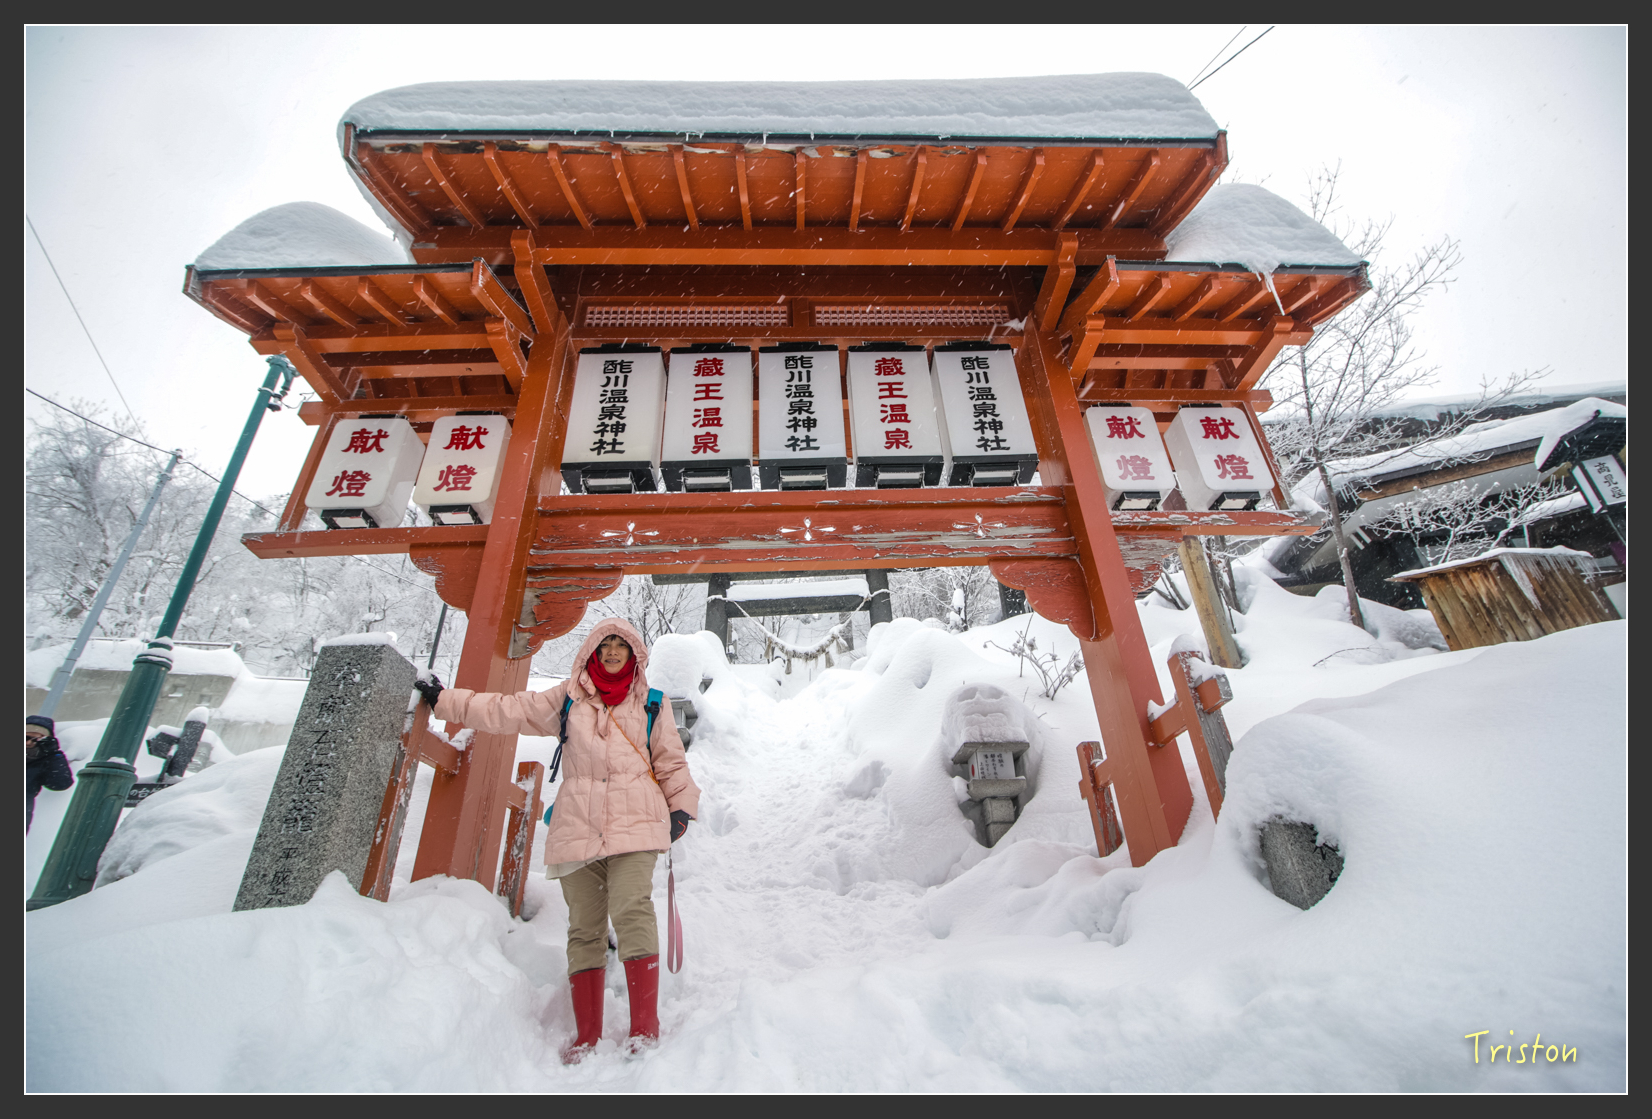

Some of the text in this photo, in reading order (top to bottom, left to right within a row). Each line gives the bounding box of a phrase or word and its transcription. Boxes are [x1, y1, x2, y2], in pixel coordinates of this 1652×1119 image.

[589, 359, 634, 456] 酢川温泉神社
[690, 357, 725, 454] 蔵王温泉
[784, 355, 821, 452] 酢川温泉神社
[874, 357, 912, 450] 蔵王温泉
[960, 355, 1011, 452] 酢川温泉神社
[1105, 415, 1156, 481] 献燈
[1199, 416, 1254, 481] 献燈
[325, 428, 390, 498] 献燈
[432, 425, 489, 492] 献燈
